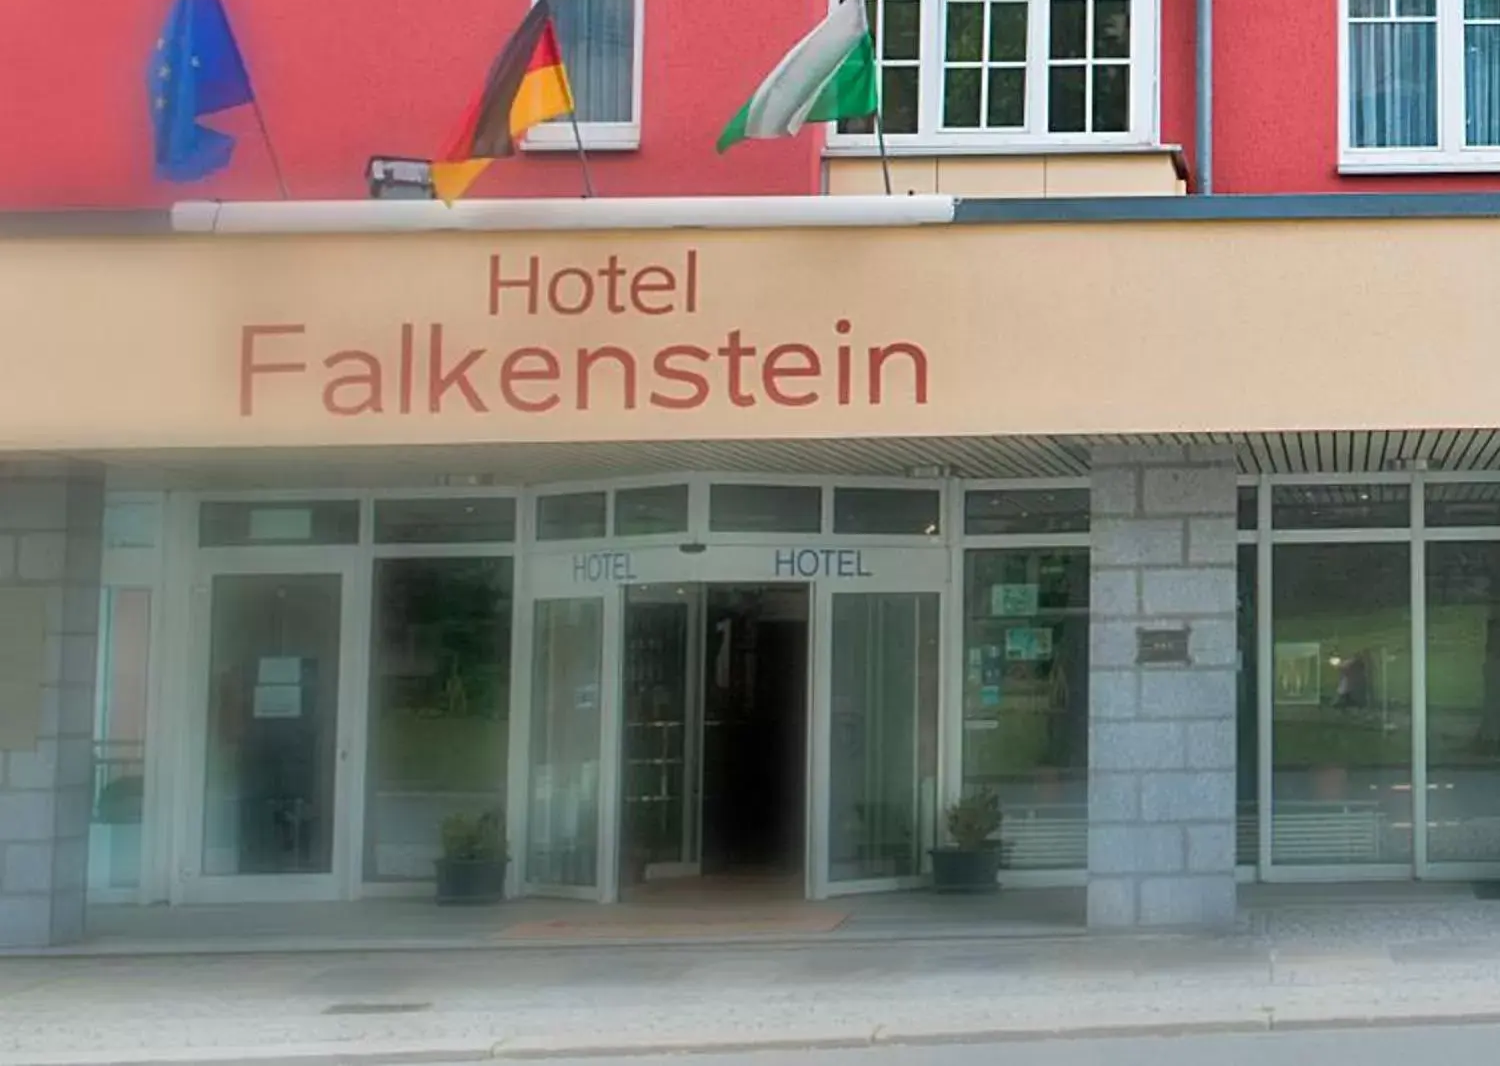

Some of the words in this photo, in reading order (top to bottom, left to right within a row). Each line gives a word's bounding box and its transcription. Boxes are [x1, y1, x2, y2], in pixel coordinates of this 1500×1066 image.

[488, 250, 698, 315] Hotel
[238, 320, 931, 418] Falkenstein
[572, 553, 638, 582] HOTEL
[775, 549, 874, 578] HOTEL
